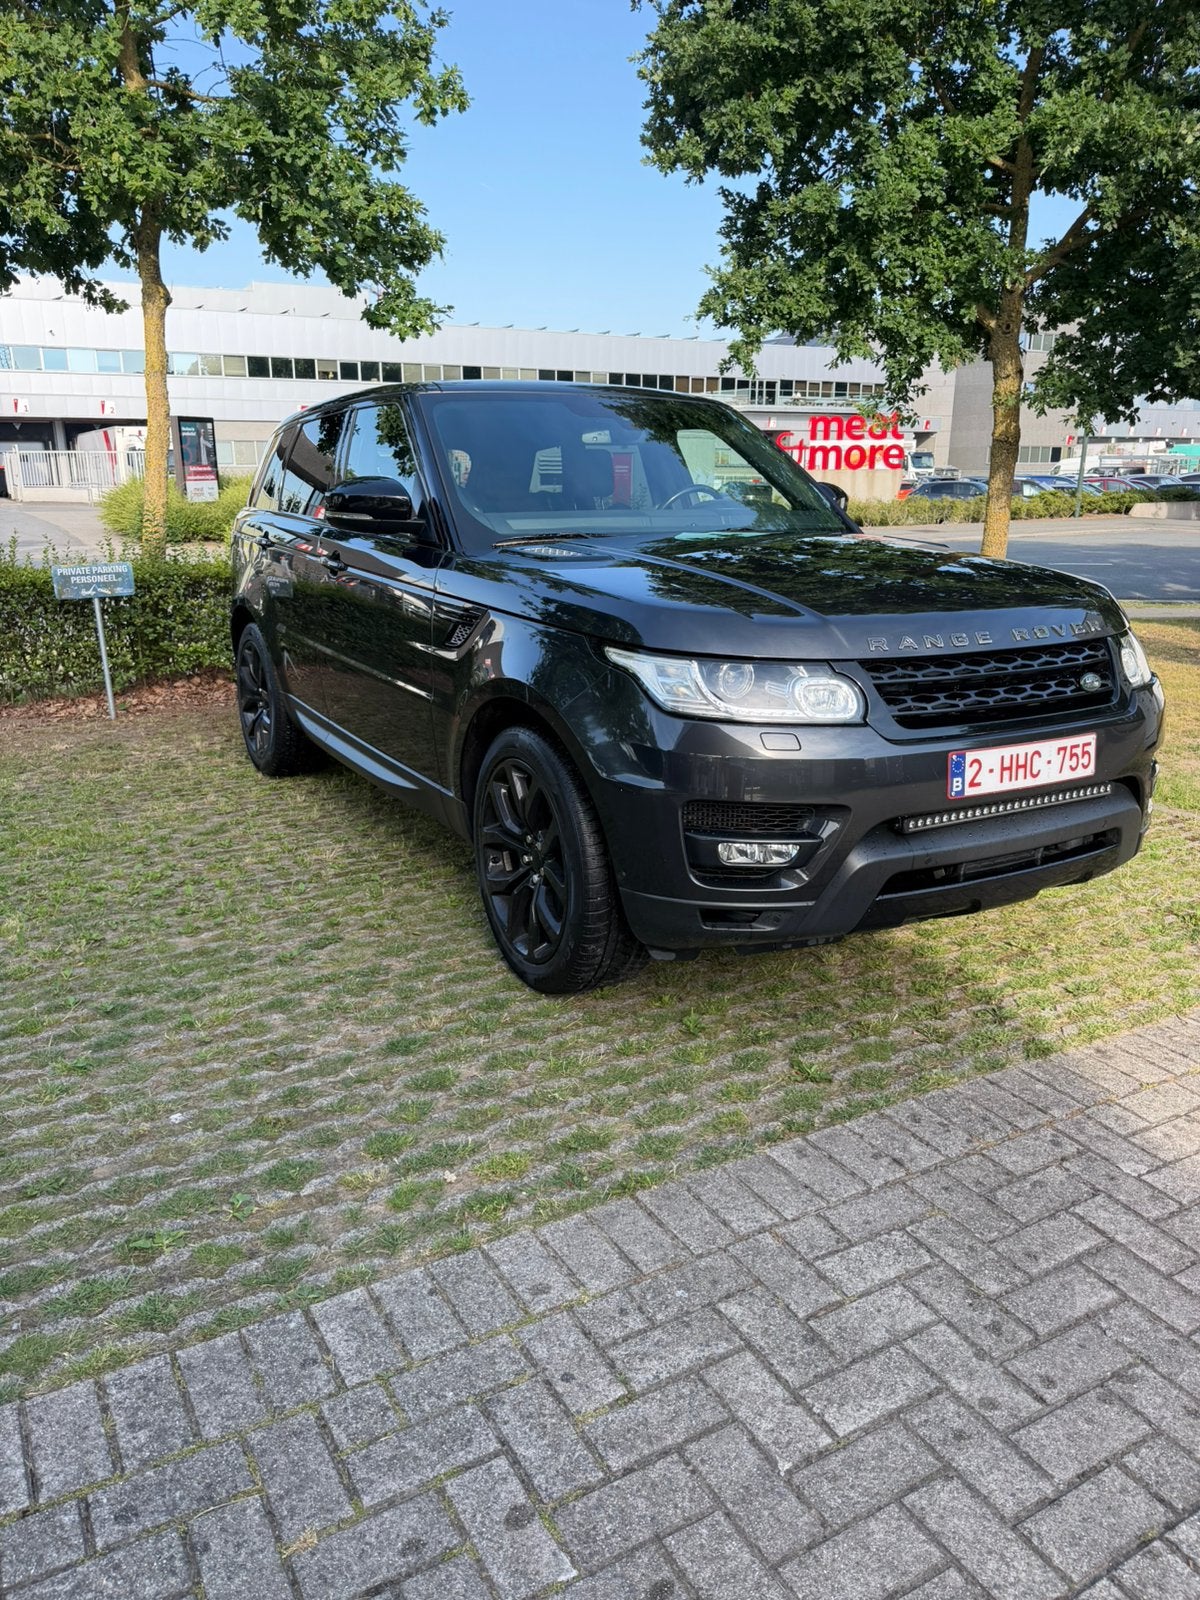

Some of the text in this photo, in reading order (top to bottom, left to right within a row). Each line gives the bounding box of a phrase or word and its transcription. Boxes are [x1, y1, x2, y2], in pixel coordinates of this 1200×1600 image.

[809, 411, 905, 440] meat
[808, 444, 905, 470] more
[57, 565, 128, 576] PRIVATE PARKING
[70, 574, 117, 584] PERSONEEL
[867, 620, 1101, 651] RANGE ROVER
[952, 777, 963, 792] B
